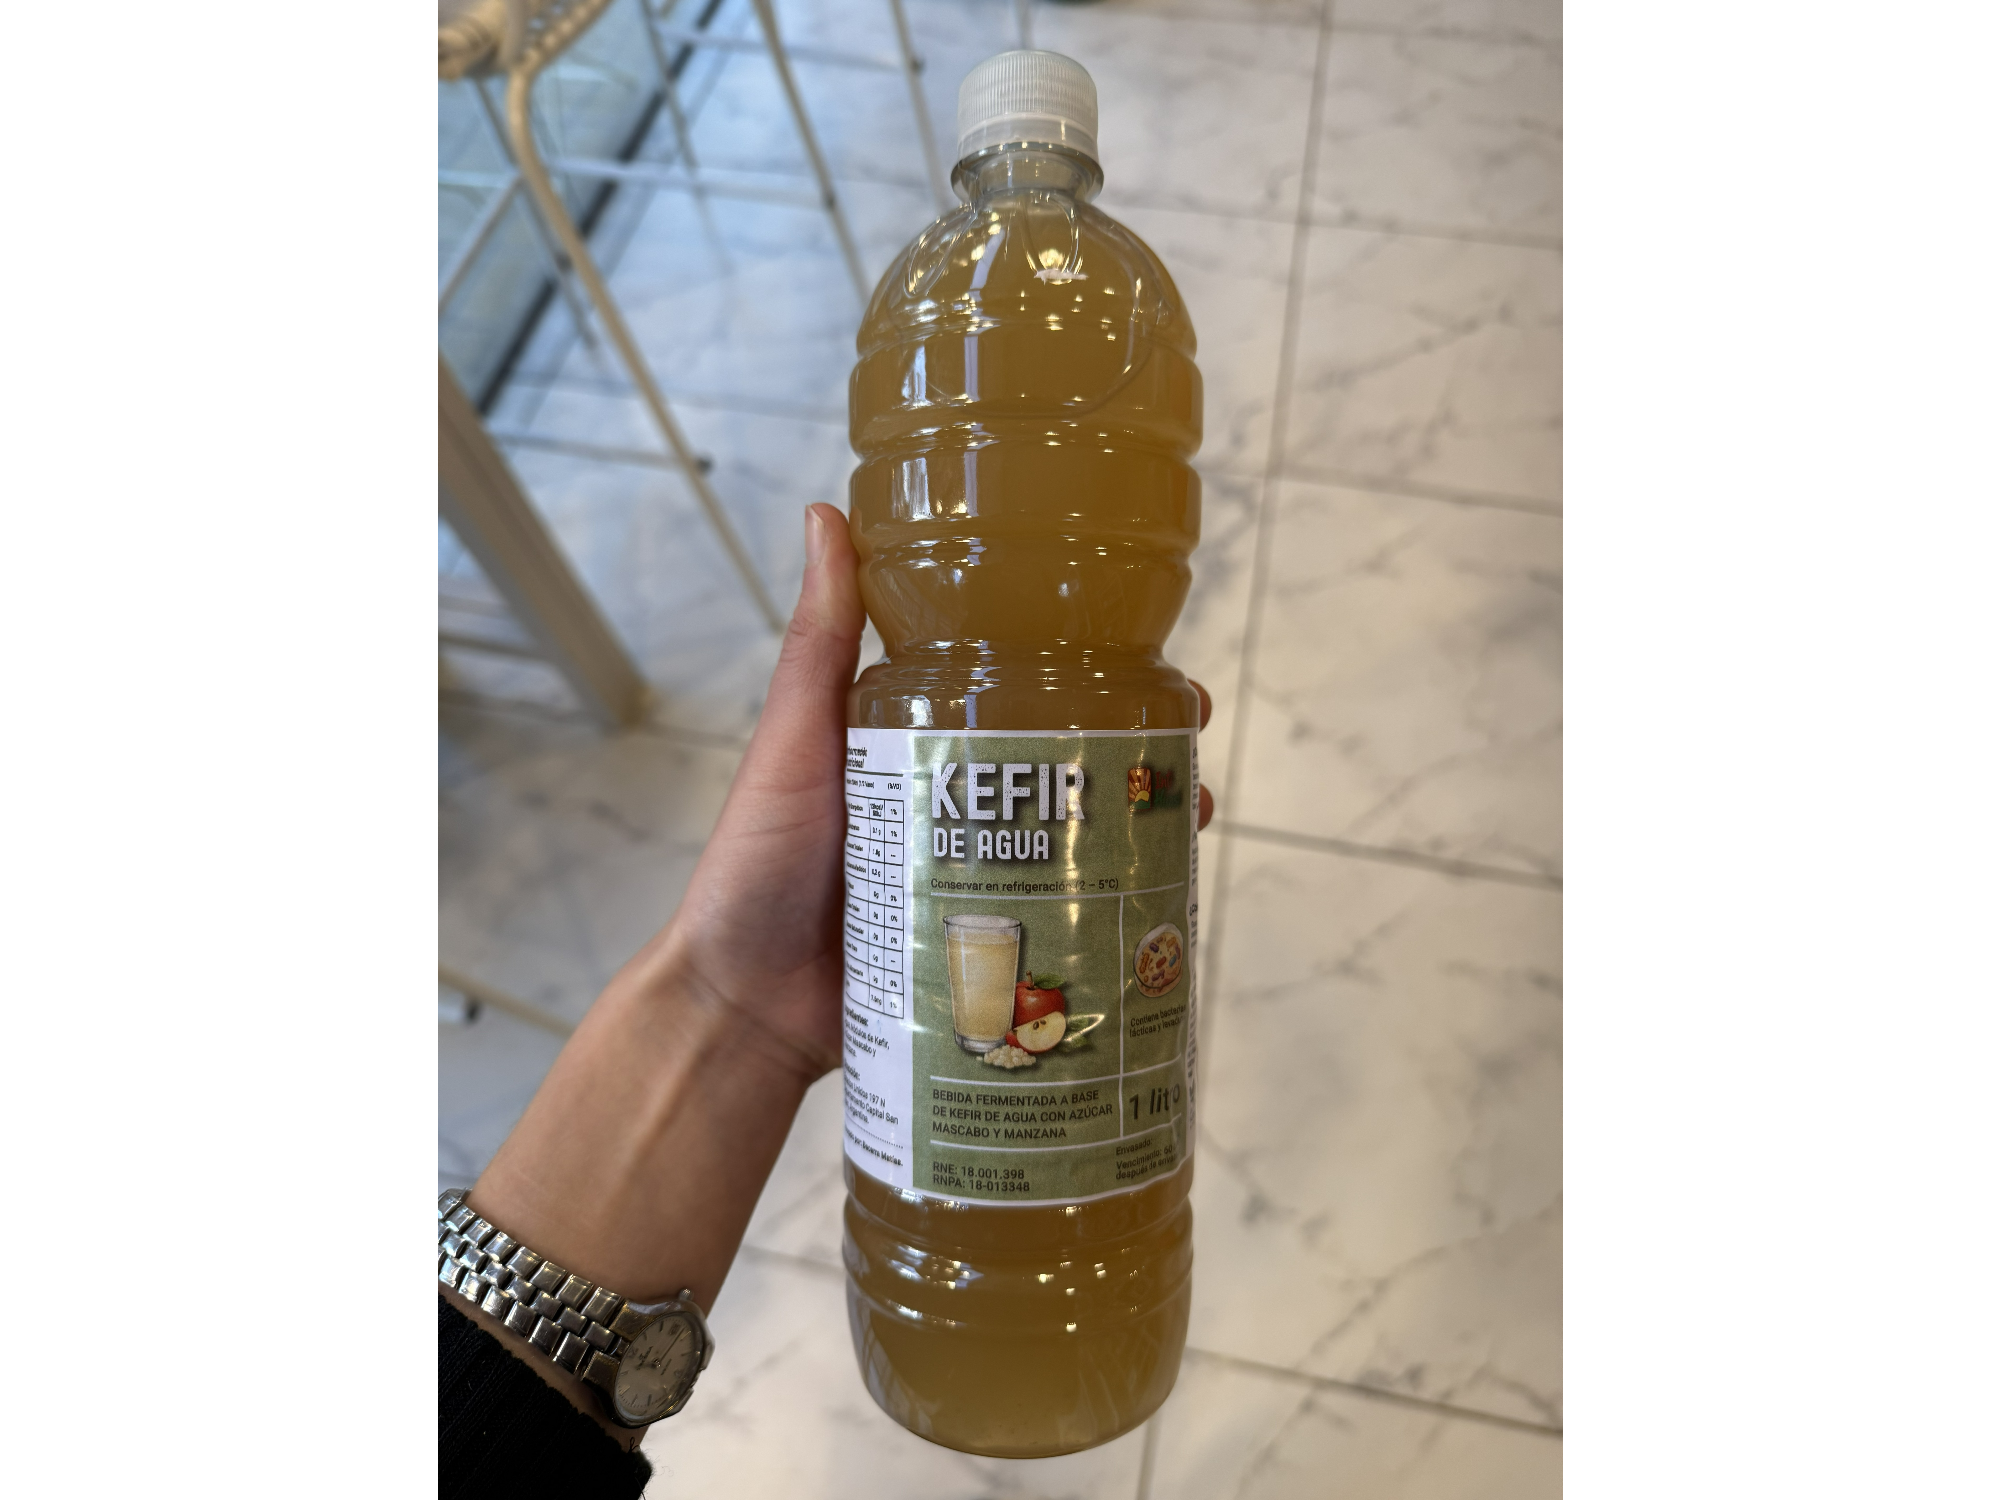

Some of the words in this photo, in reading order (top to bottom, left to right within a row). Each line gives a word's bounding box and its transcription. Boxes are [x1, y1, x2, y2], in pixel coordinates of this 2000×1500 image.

[930, 762, 1085, 821] KEFIR
[932, 827, 966, 859] DE
[977, 829, 1050, 860] AGUA
[930, 878, 983, 891] Conservar
[985, 883, 999, 892] en
[1002, 880, 1071, 894] refrigeración
[1098, 878, 1119, 891] 5°C)
[1130, 1013, 1159, 1027] Contiene
[1130, 1025, 1156, 1038] lácticas
[1157, 1022, 1162, 1033] y
[880, 1097, 887, 1108] N
[932, 1089, 973, 1105] BEBIDA
[976, 1094, 1058, 1107] FERMENTADA
[1060, 1094, 1069, 1106] A
[1071, 1090, 1099, 1104] BASE
[1129, 1094, 1139, 1120] 1
[885, 1112, 900, 1125] San
[932, 1105, 947, 1116] DE
[949, 1107, 982, 1121] KEFIR
[985, 1111, 1001, 1122] DE
[1003, 1111, 1037, 1123] AGUA
[1040, 1110, 1066, 1123] CON
[1068, 1103, 1113, 1121] AZÚCAR
[932, 1121, 990, 1138] MASCABO
[993, 1127, 1001, 1138] Y
[1004, 1127, 1067, 1139] MANZANA
[1115, 1138, 1153, 1156] Envasado:
[1116, 1149, 1162, 1170] Vencimiento:
[932, 1161, 958, 1175] RNE:
[961, 1165, 1025, 1180] 18.001.398
[1116, 1164, 1148, 1180] después
[1149, 1161, 1157, 1171] de
[932, 1173, 966, 1189] RNPA:
[969, 1180, 1031, 1192] 18-013348
